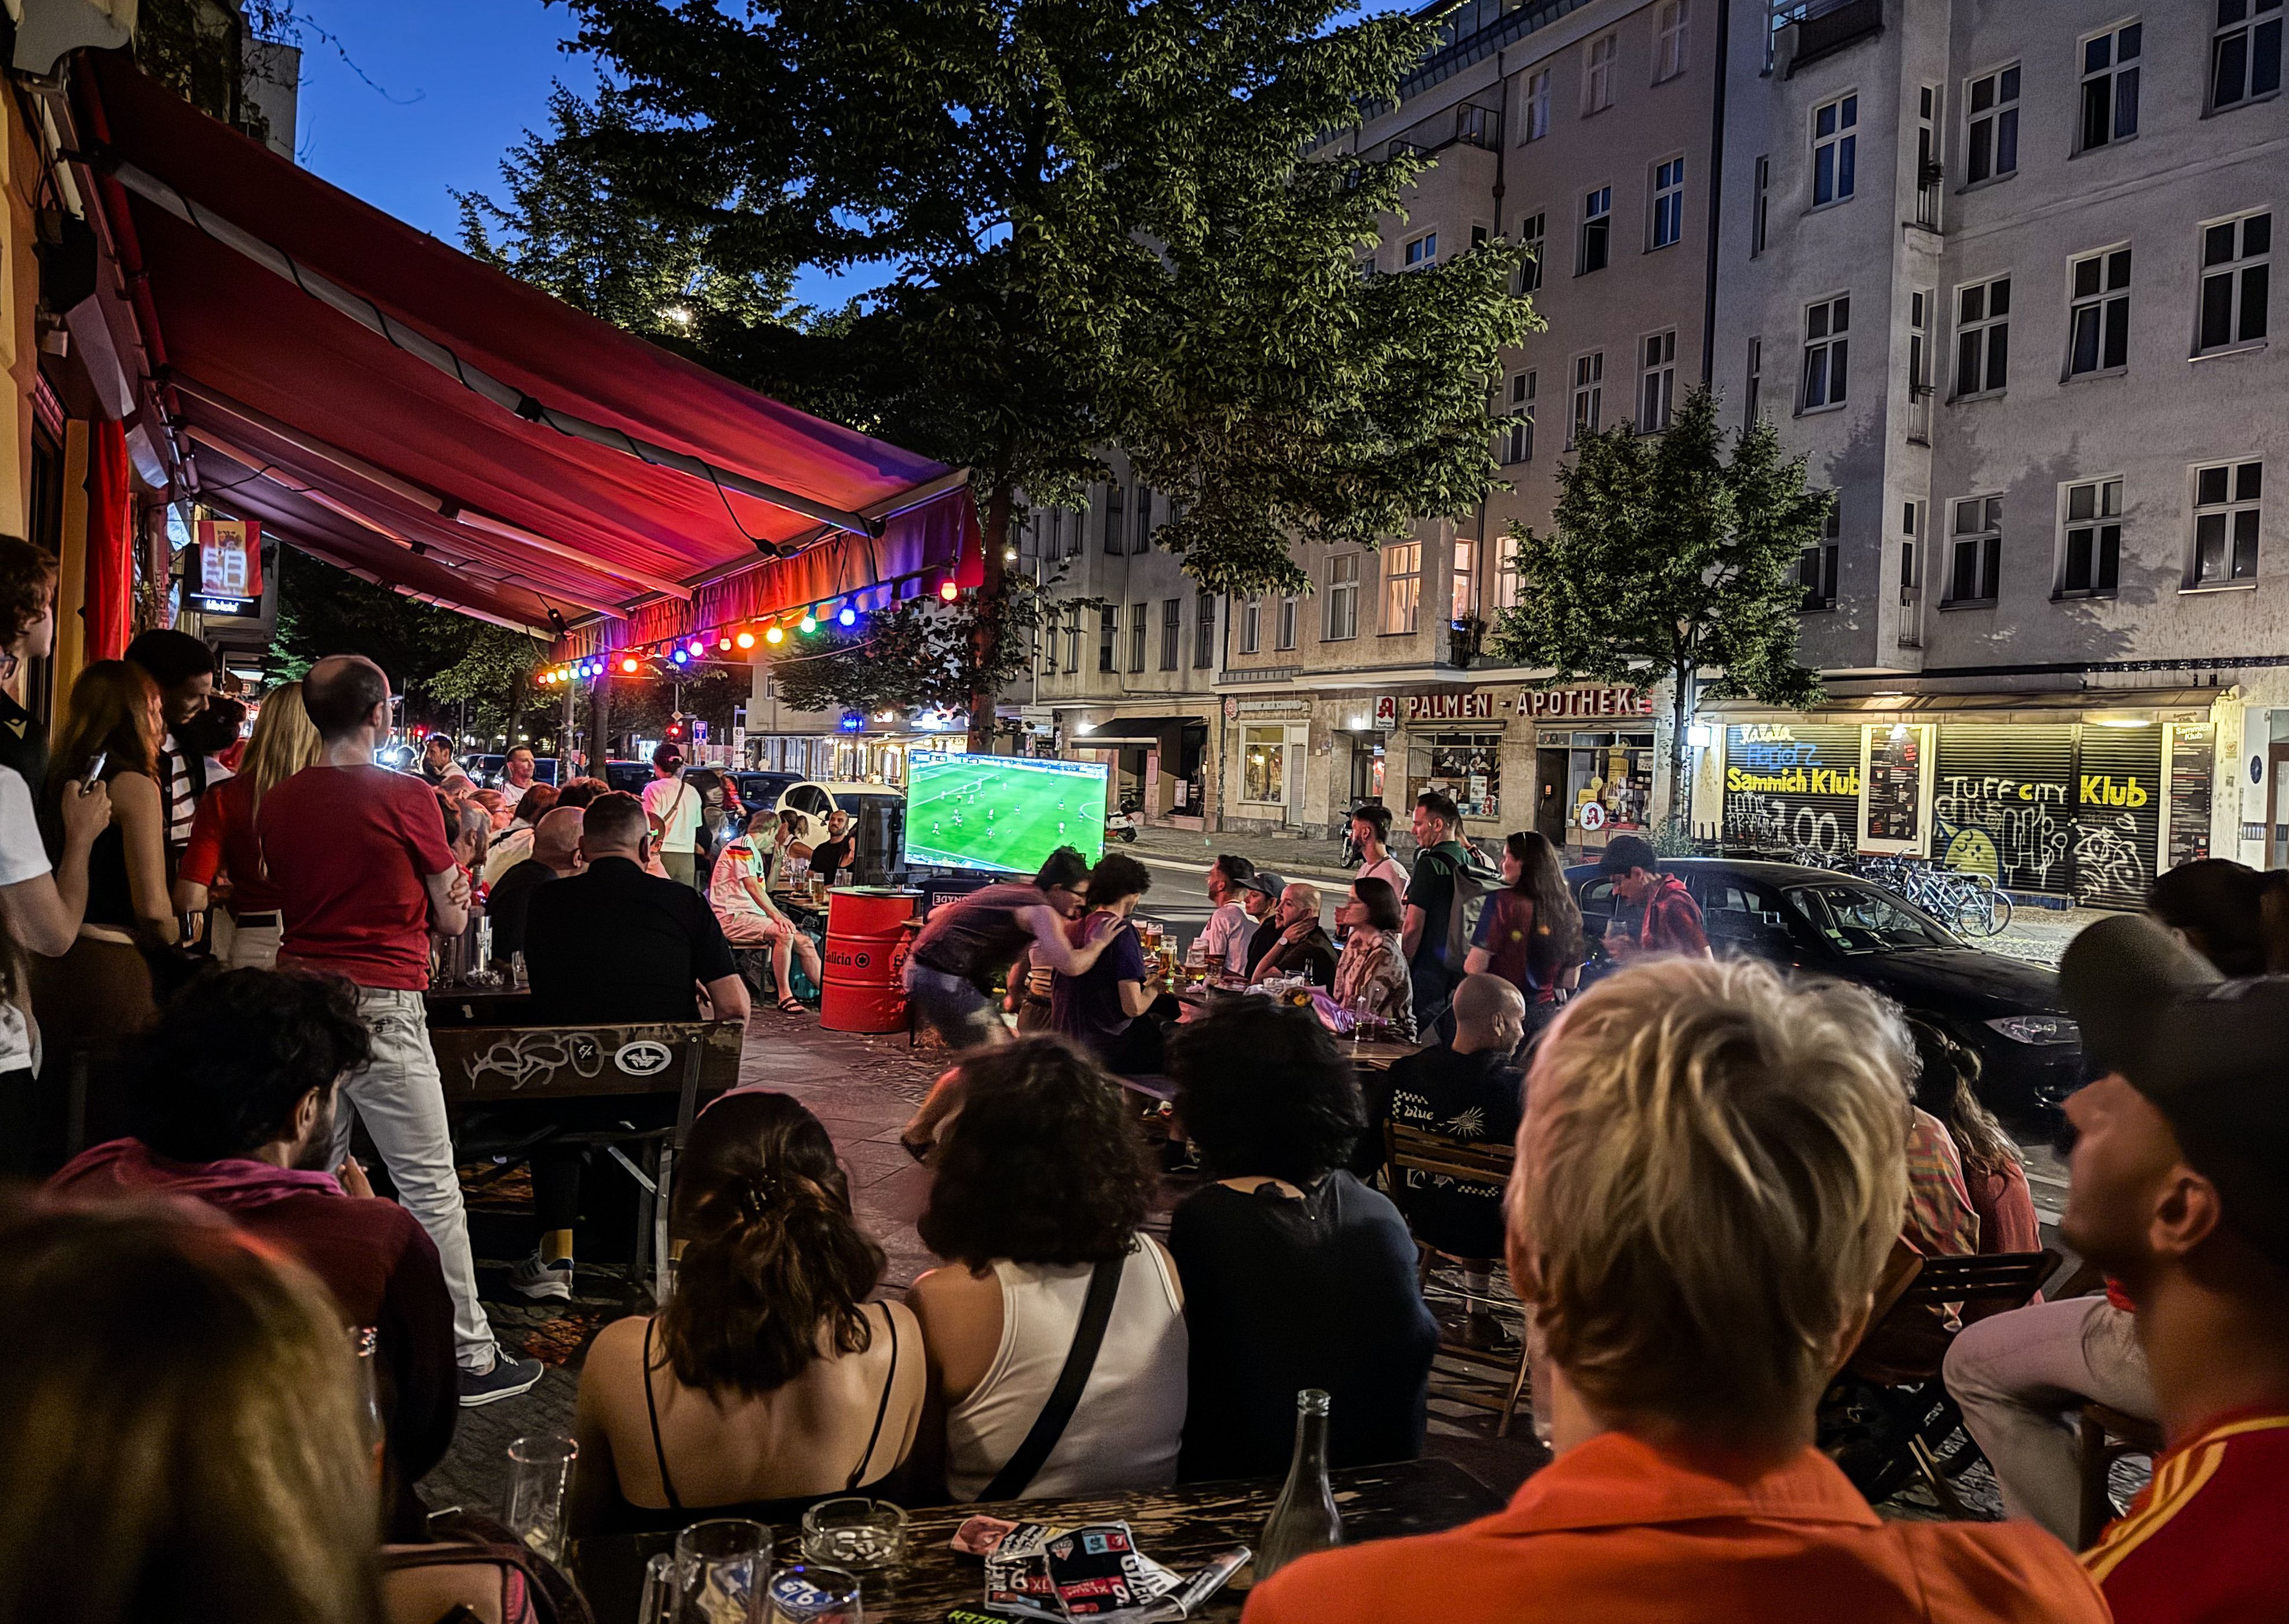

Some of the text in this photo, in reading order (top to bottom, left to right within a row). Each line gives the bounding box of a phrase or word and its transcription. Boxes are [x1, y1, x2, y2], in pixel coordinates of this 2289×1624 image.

[1408, 694, 1492, 717] PALMEN
[1516, 688, 1651, 716] APOTHEKE
[2175, 725, 2212, 735] Sammich
[2184, 732, 2203, 741] Klub
[1727, 766, 1860, 795] Sammich Klub
[1944, 775, 2147, 807] TUFF CITY Klub
[935, 895, 971, 903] ONADE
[1404, 1104, 1434, 1121] blue
